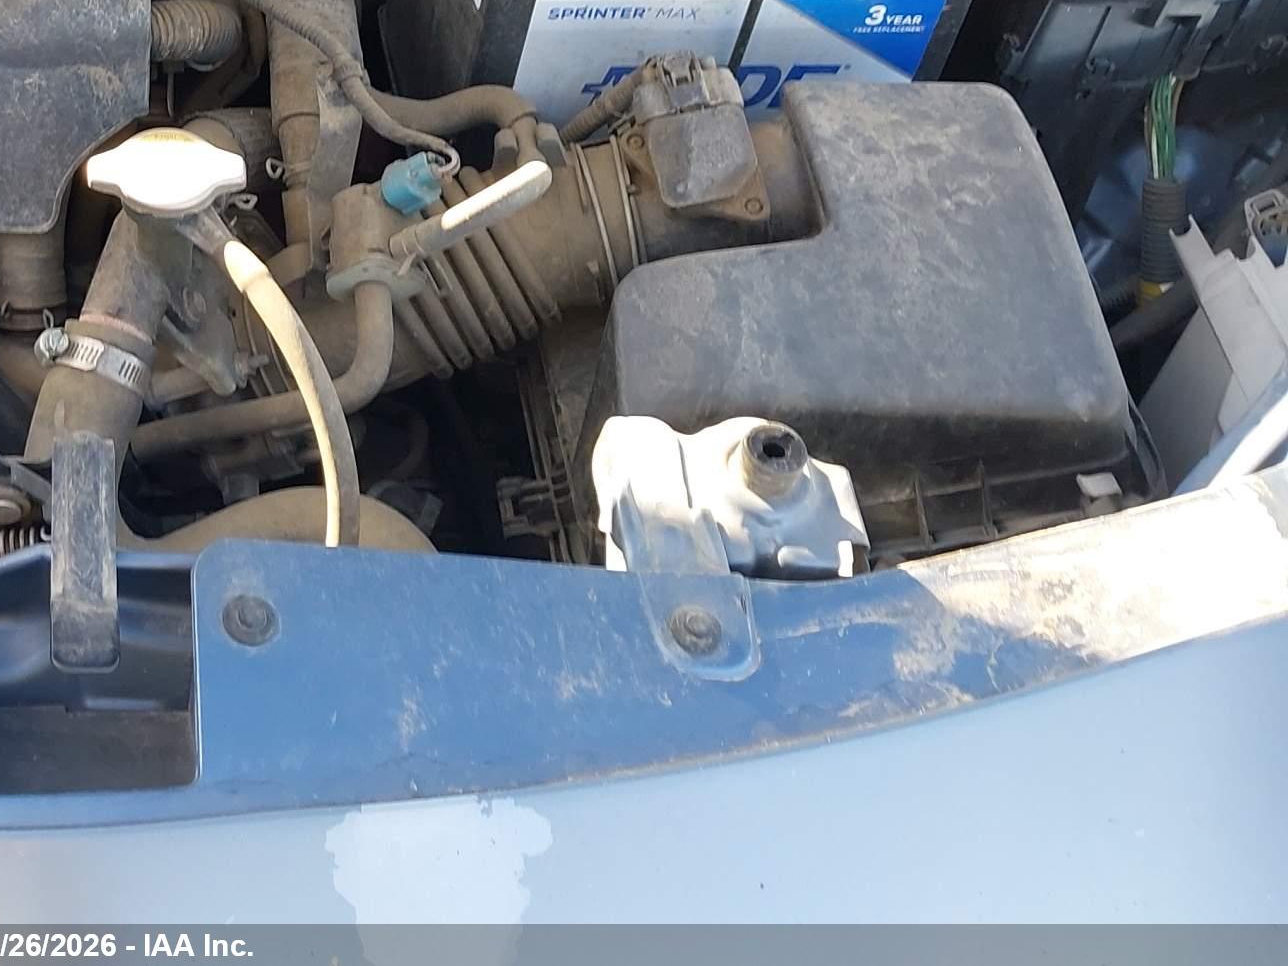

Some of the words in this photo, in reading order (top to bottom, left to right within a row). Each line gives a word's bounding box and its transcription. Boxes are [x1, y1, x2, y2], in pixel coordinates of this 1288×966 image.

[547, 6, 647, 20] SPRINTER
[655, 7, 701, 19] MAX
[864, 3, 887, 26] 3
[886, 14, 923, 25] YEAR
